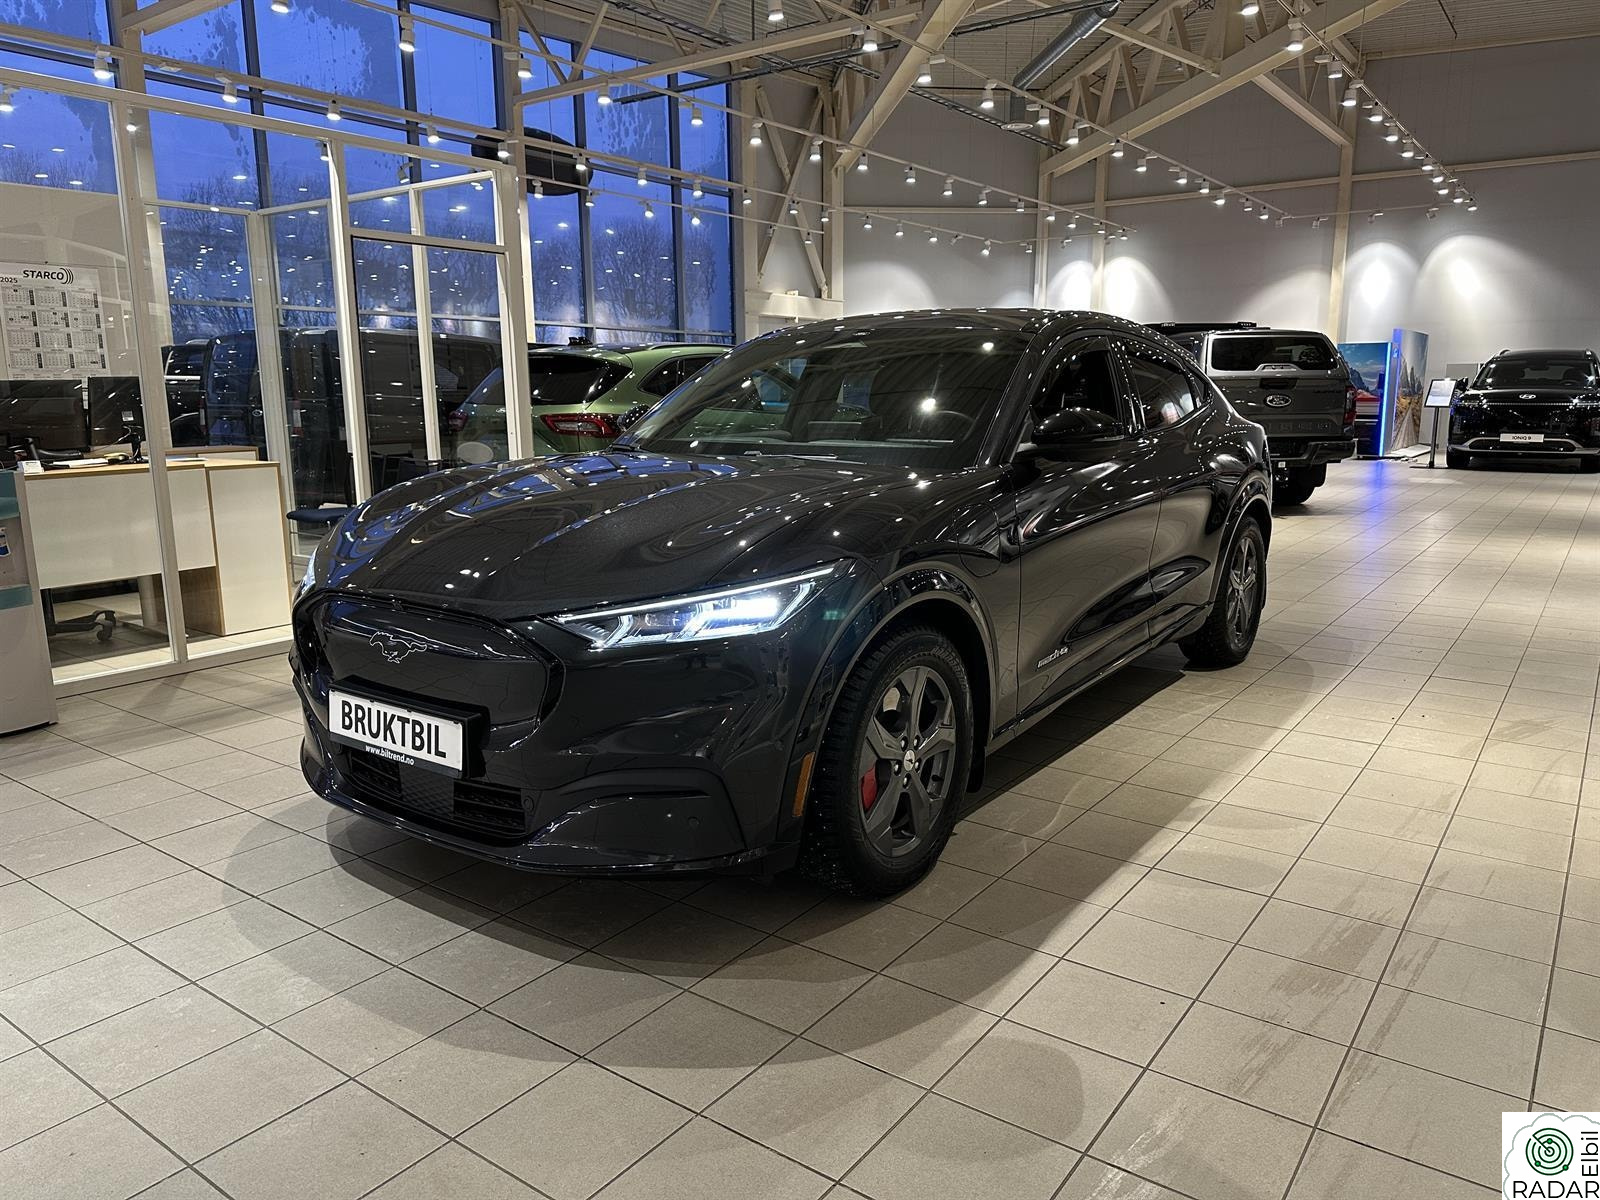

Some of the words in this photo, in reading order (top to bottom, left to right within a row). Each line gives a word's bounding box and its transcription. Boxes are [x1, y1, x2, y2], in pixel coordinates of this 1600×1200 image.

[23, 269, 64, 280] STARCO
[341, 700, 447, 758] BRUKTBIL
[365, 744, 415, 766] www.biltrend.no
